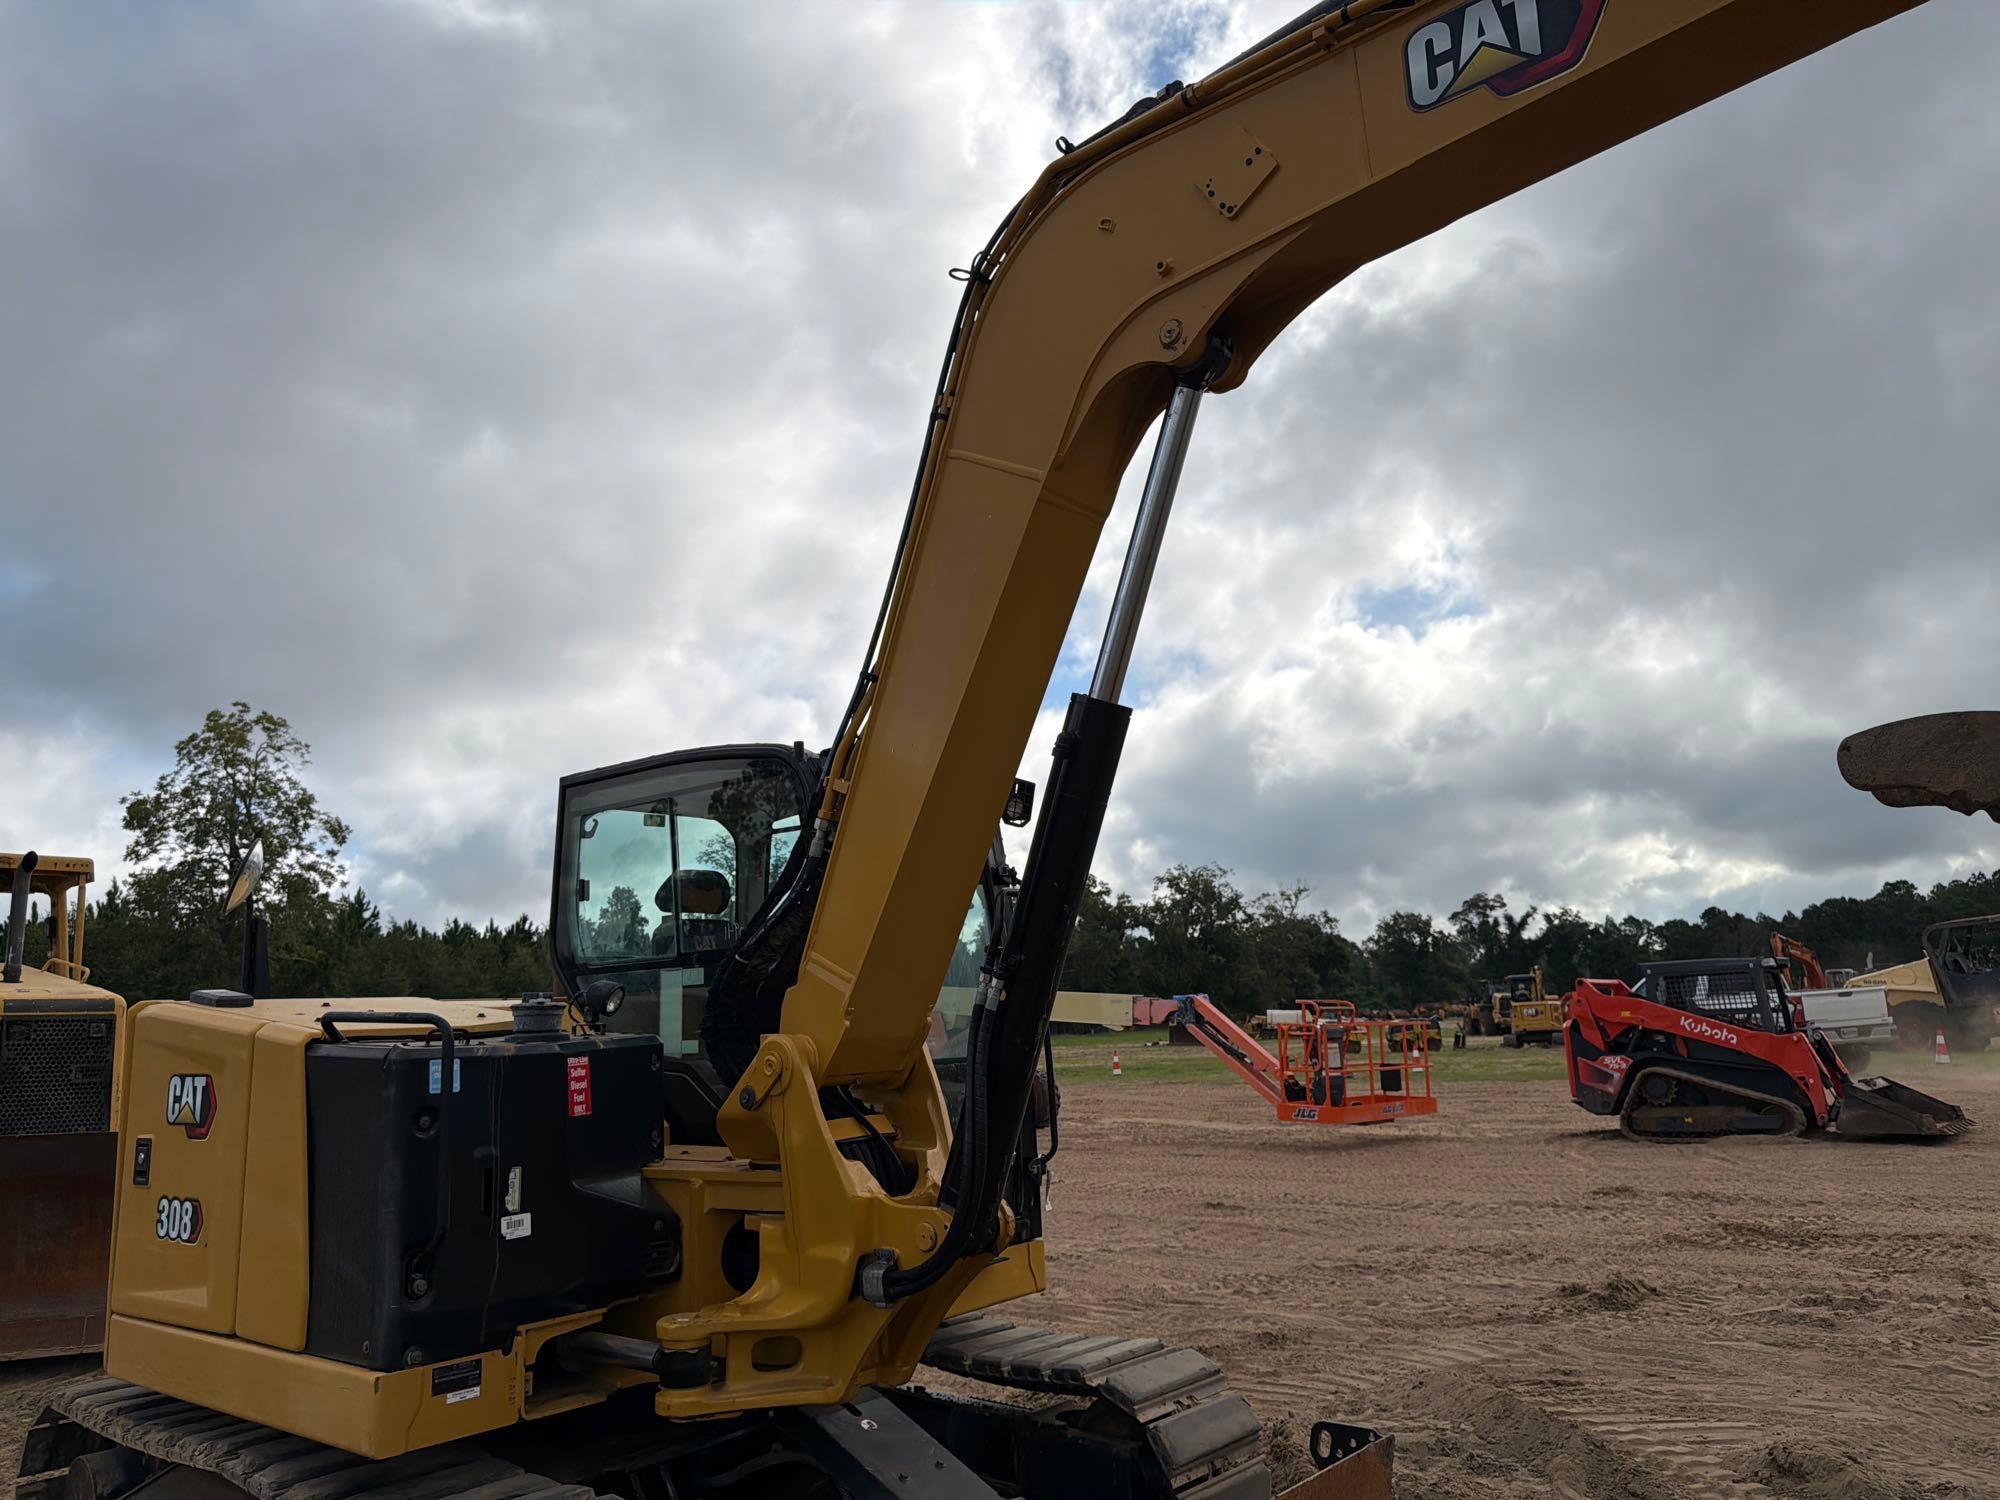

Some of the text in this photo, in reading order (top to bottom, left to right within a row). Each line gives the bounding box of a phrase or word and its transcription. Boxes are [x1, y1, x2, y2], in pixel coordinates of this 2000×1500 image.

[1408, 0, 1542, 106] CAT
[1680, 1016, 1738, 1045] Kubota
[570, 1079, 588, 1090] Diesel
[573, 1092, 586, 1103] Fuel
[167, 1075, 207, 1124] CAT
[1292, 1107, 1318, 1120] JLG
[156, 1198, 194, 1241] 308
